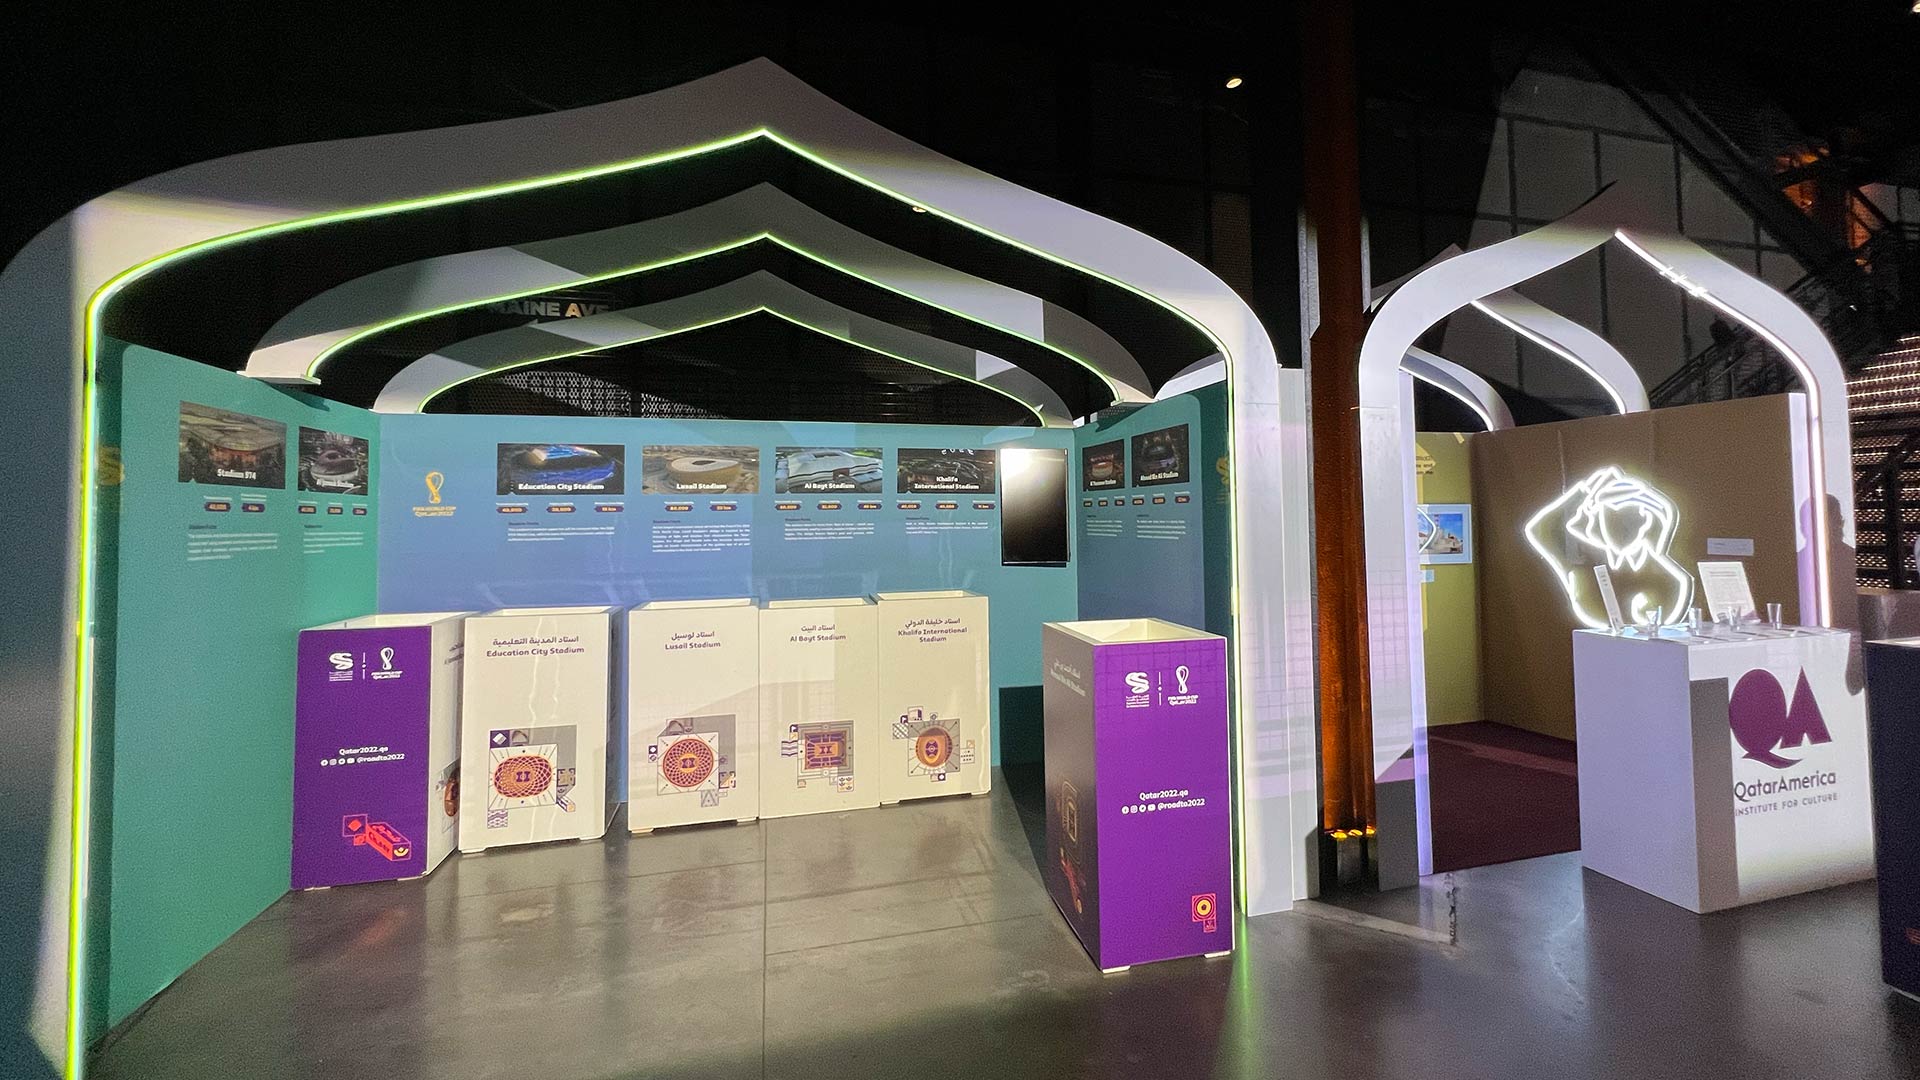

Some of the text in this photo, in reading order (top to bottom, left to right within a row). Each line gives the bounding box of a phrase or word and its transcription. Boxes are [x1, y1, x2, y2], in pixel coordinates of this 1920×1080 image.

[557, 483, 573, 491] City
[812, 482, 828, 490] Bayt
[905, 620, 924, 629] الدولي
[922, 627, 968, 635] International
[529, 636, 557, 646] المدينة
[671, 632, 695, 641] لوسيل
[798, 634, 816, 643] Bayt
[493, 638, 528, 648] التعليمية
[689, 641, 721, 649] Stadium
[486, 647, 584, 657] Education City Stadium
[339, 746, 389, 755] Qatar2022.qa
[357, 753, 405, 763] @roadto2022
[1734, 770, 1837, 802] QatarAmerica
[1139, 789, 1189, 800] Qatar2022.qa
[1158, 798, 1206, 811] @roadto2022
[1735, 792, 1839, 816] INSTITUTE FOR CULTURE
